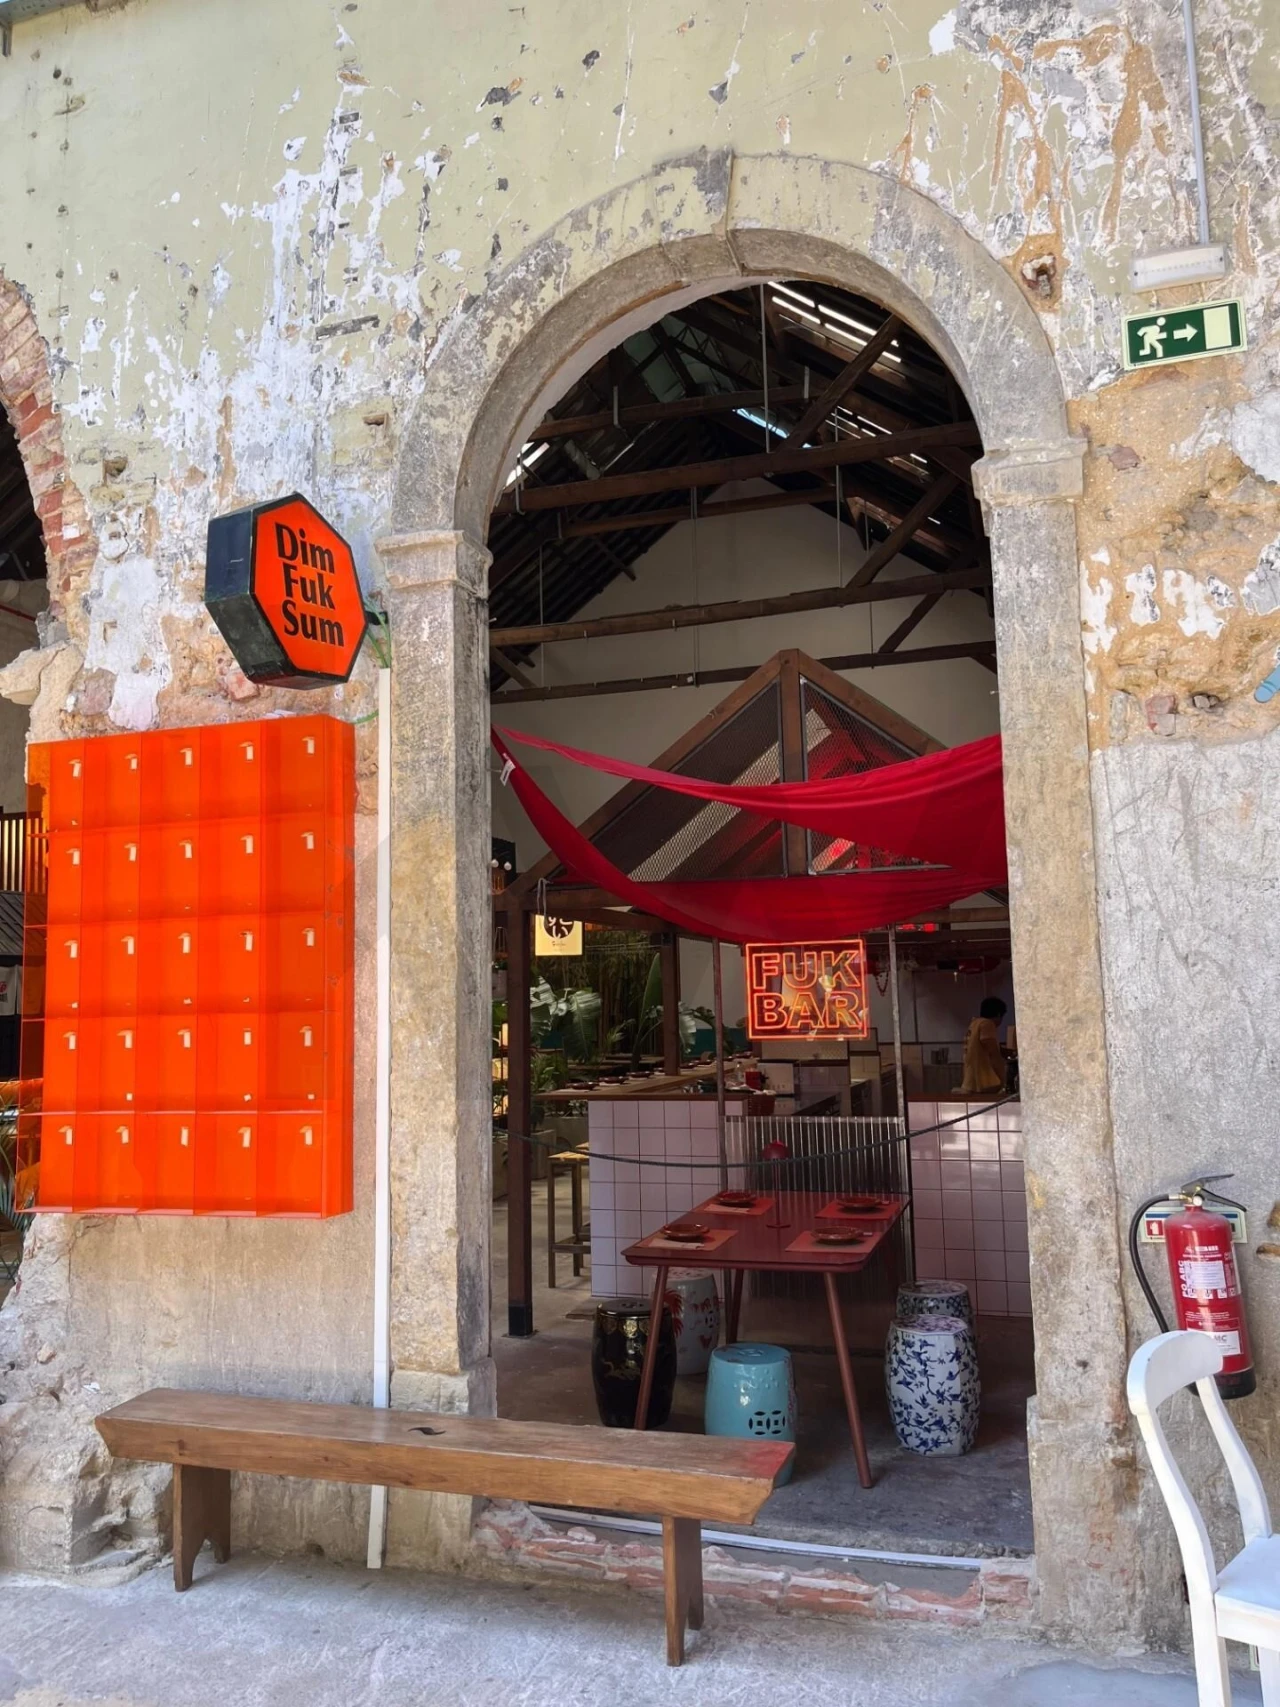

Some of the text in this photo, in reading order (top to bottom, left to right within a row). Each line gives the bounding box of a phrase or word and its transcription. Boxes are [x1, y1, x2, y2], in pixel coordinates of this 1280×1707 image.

[275, 522, 335, 574] Dim
[283, 562, 336, 610] Fuk
[282, 600, 344, 647] Sum
[752, 950, 861, 990] FUK
[753, 991, 862, 1030] BAR
